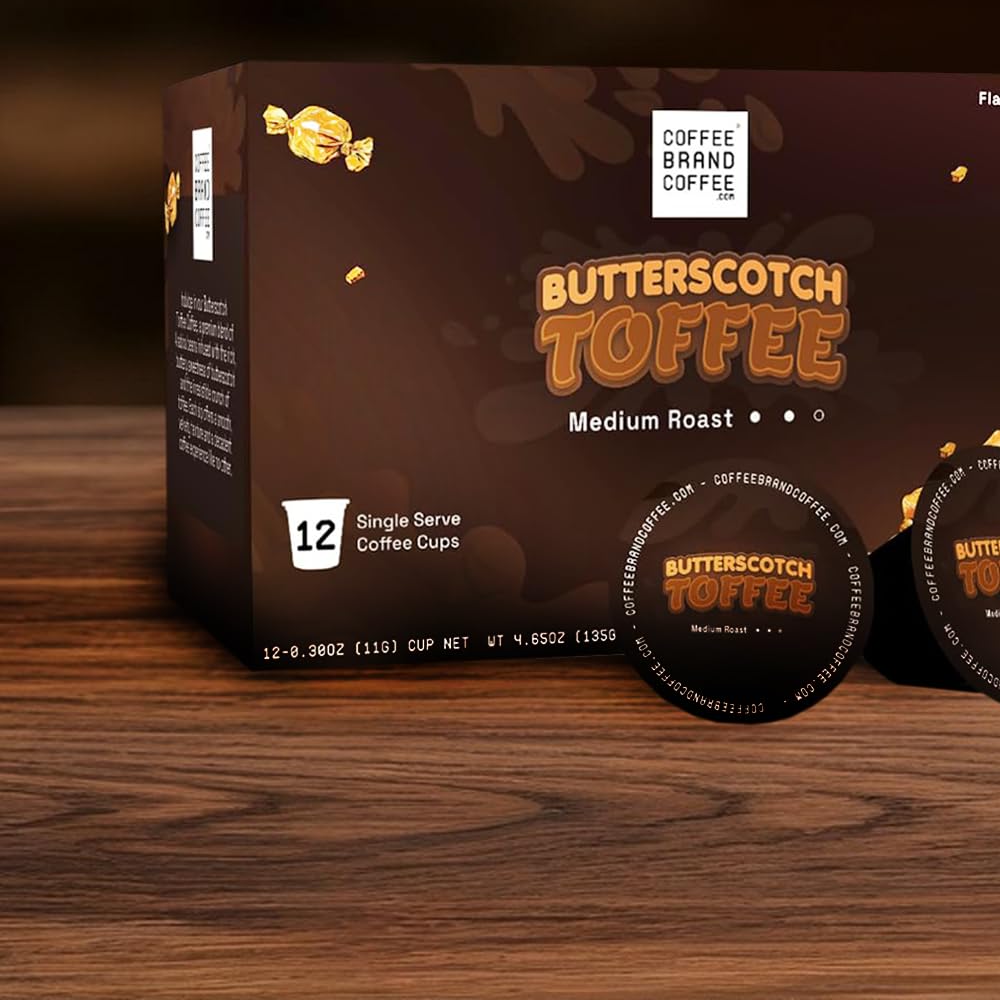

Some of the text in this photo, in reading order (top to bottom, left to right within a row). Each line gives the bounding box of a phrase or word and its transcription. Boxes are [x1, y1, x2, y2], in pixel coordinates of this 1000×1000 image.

[663, 129, 735, 147] COFFEE
[663, 151, 735, 169] BRAND
[663, 174, 735, 191] COFFEE
[542, 258, 842, 312] BUTTERSCOTCH
[540, 301, 846, 389] TOFFEE
[568, 408, 734, 433] Medium Roast
[356, 511, 461, 531] Single Serve
[297, 519, 336, 551] 12
[356, 534, 460, 552] Coffee Cups
[665, 554, 813, 580] BUTTERSCOTCH
[664, 574, 815, 613] TOFFEE
[724, 625, 747, 634] Roast
[355, 639, 397, 656] (11G)
[408, 638, 434, 652] CUP
[443, 636, 469, 650] NET
[487, 634, 504, 648] WT
